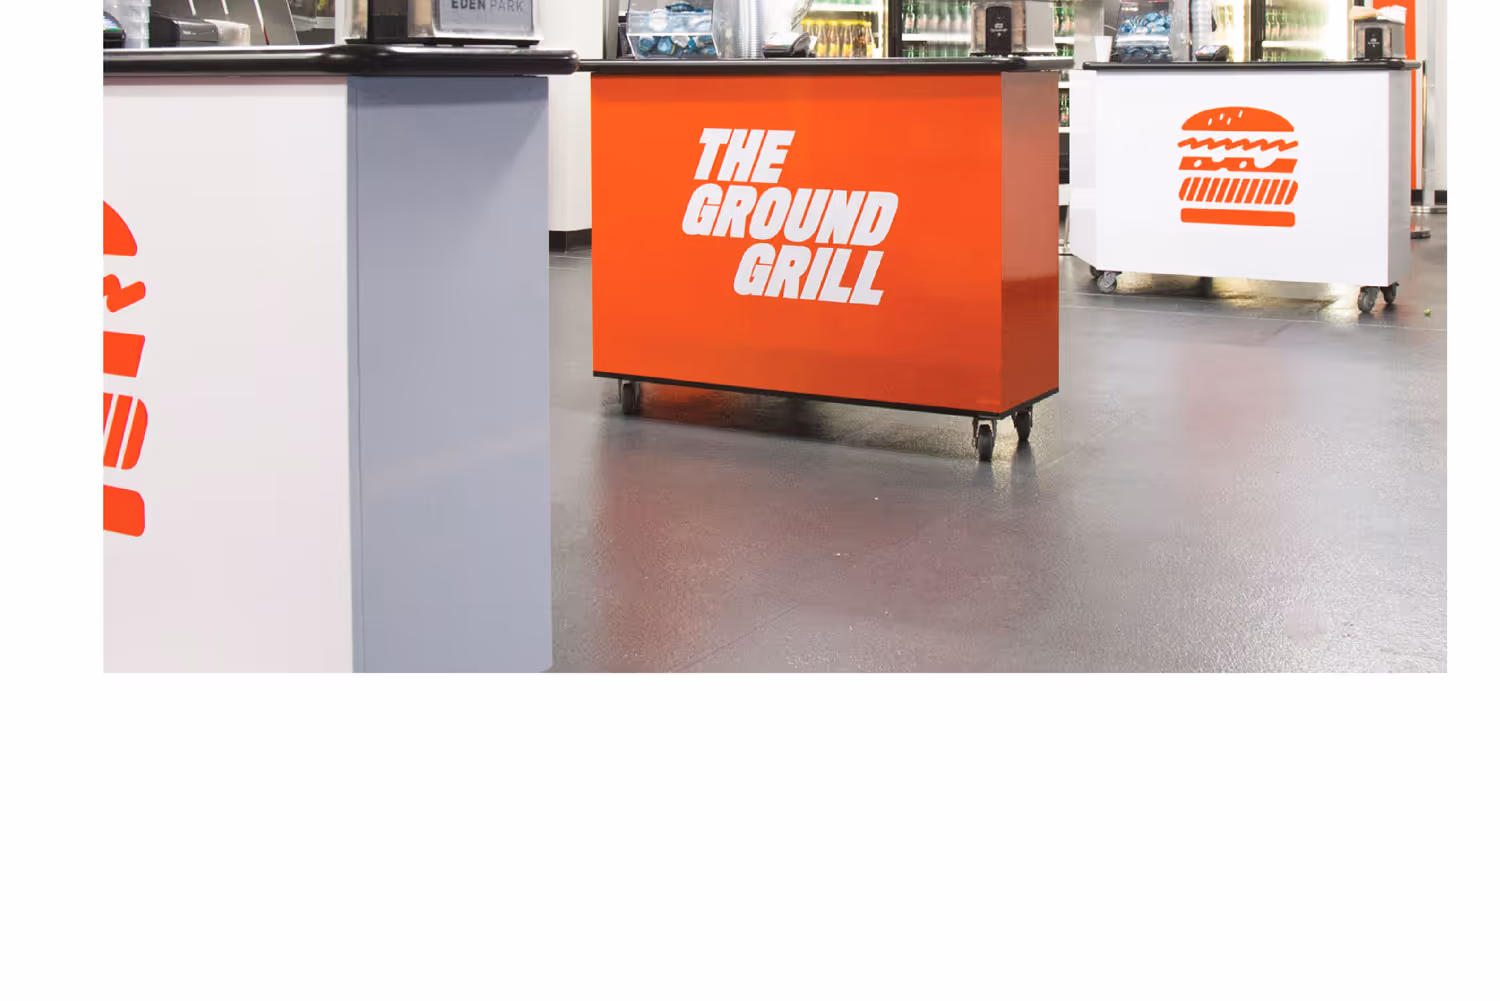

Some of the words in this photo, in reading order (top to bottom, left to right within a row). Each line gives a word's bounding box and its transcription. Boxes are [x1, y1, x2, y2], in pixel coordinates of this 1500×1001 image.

[694, 127, 796, 183] THE
[682, 183, 899, 246] GROUND
[733, 243, 884, 306] GRILL
